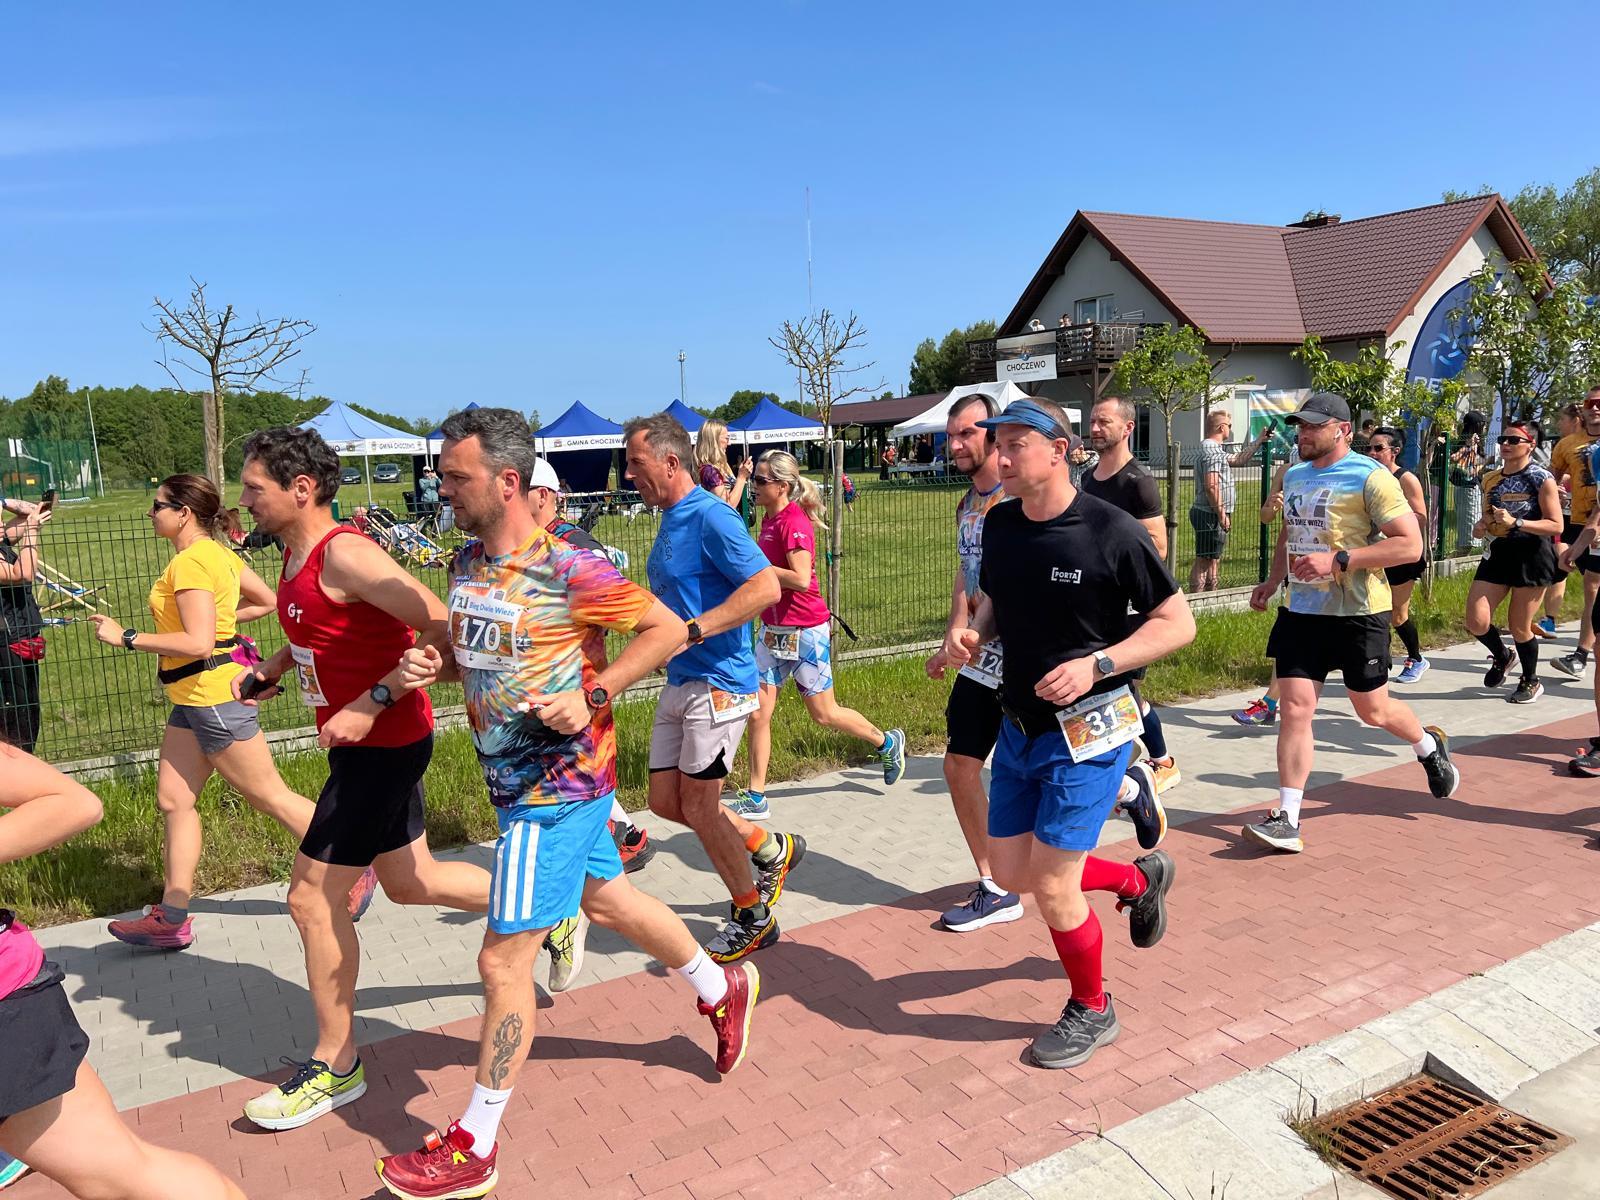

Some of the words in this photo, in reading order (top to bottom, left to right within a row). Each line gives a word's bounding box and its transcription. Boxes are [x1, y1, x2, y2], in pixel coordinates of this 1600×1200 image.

[1006, 360, 1046, 372] CHOCZEWO
[784, 430, 814, 438] CHOCZEWO
[566, 439, 588, 447] GMINA
[1054, 571, 1078, 580] PORTA
[458, 616, 501, 652] 170
[1085, 704, 1118, 737] 31
